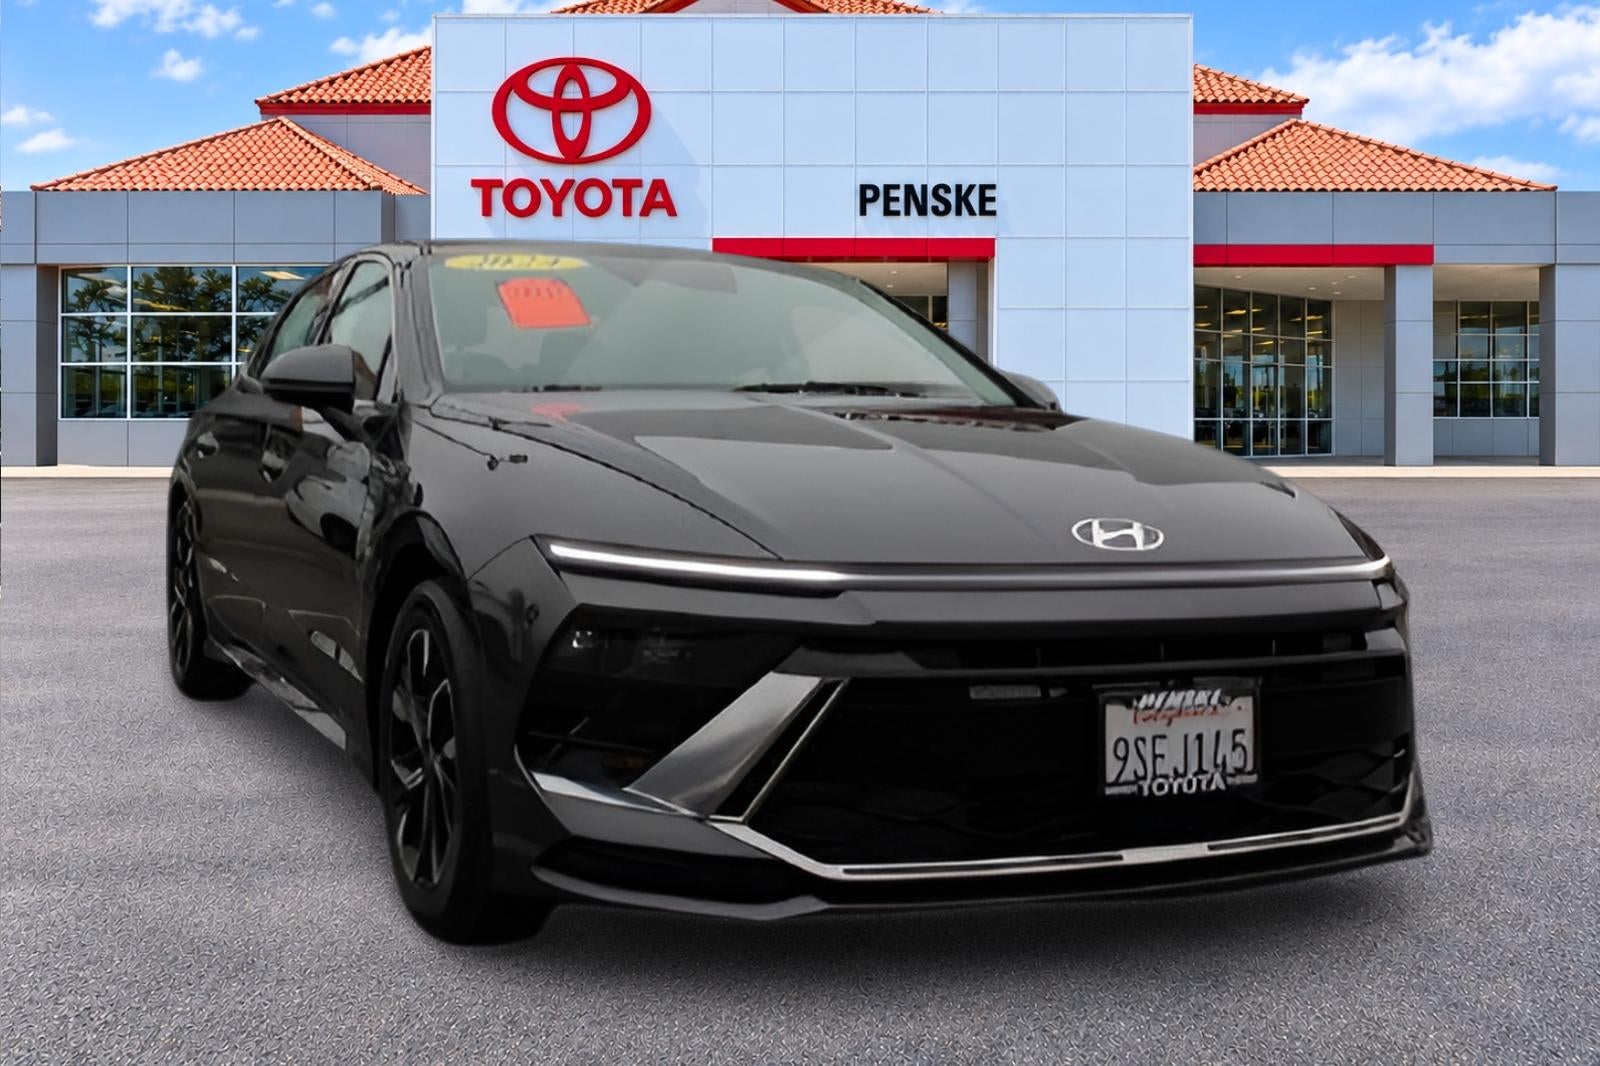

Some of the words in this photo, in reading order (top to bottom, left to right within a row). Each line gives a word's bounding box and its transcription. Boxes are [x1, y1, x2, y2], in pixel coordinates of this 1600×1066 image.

[470, 177, 678, 218] TOYOTA
[859, 183, 997, 217] PENSKE
[1138, 771, 1226, 797] TOYOTA
